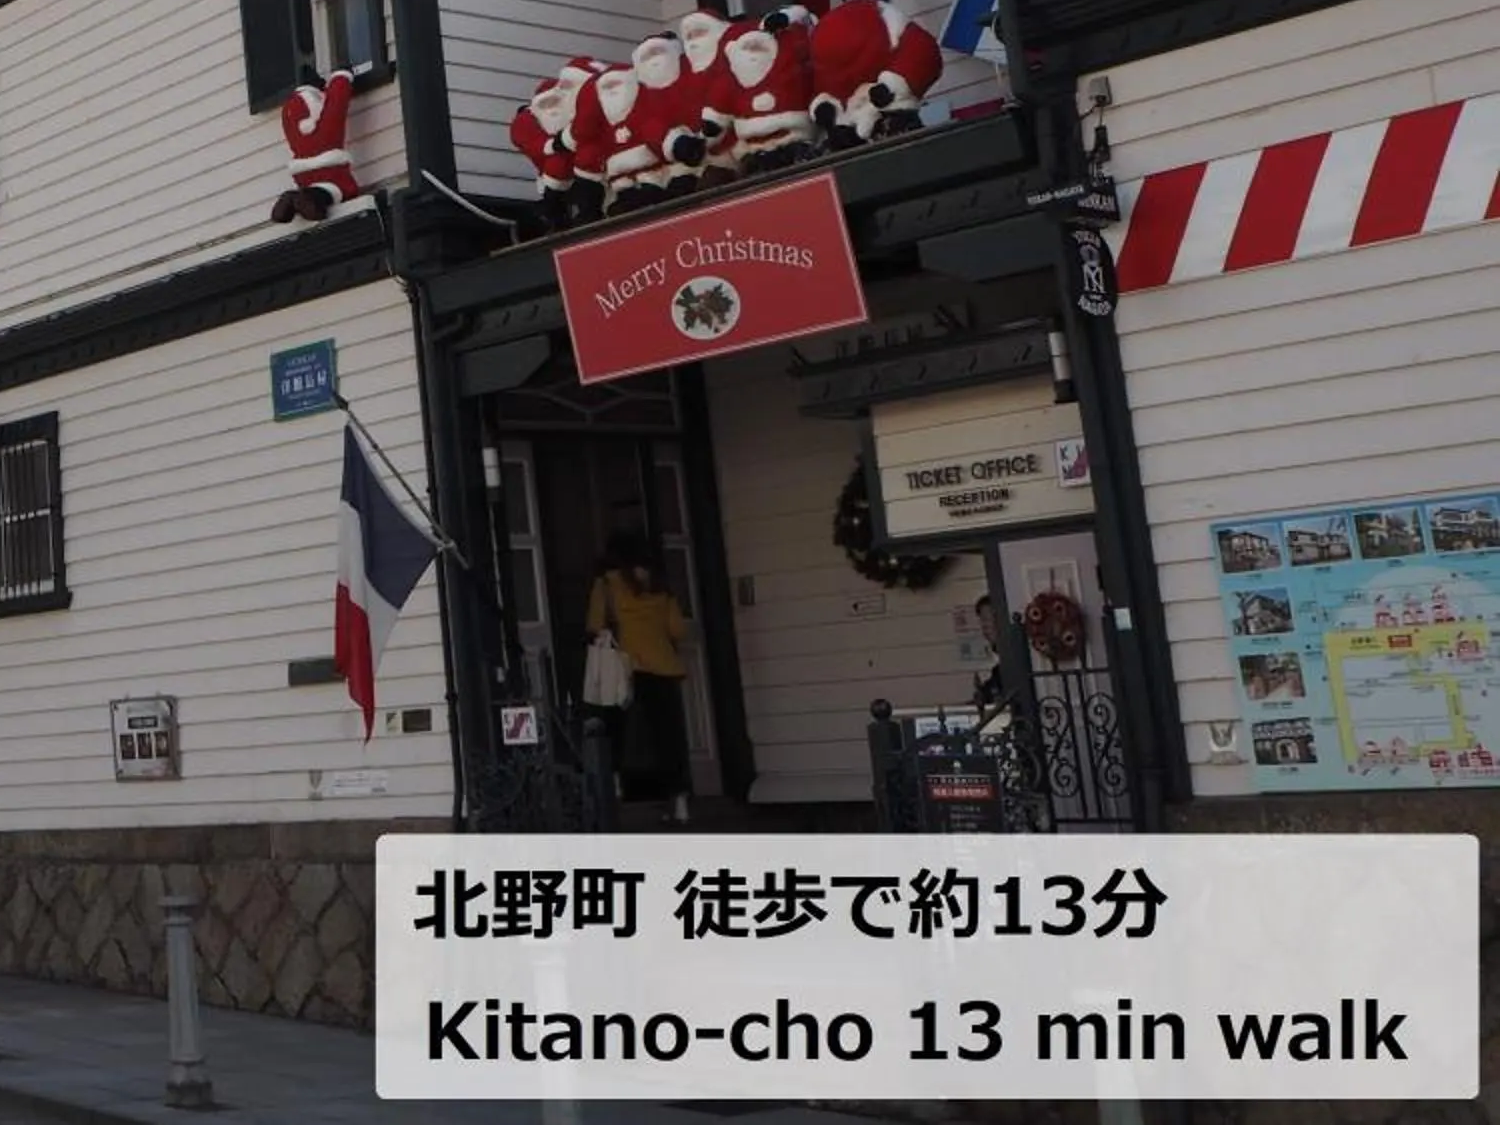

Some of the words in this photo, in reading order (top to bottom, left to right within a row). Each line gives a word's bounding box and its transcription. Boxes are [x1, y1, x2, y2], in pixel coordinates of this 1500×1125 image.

[595, 258, 666, 318] Merry
[675, 229, 814, 268] Christmas
[906, 465, 963, 491] TICKET
[971, 453, 1040, 481] OFFICE
[938, 488, 1011, 507] RECEPTION
